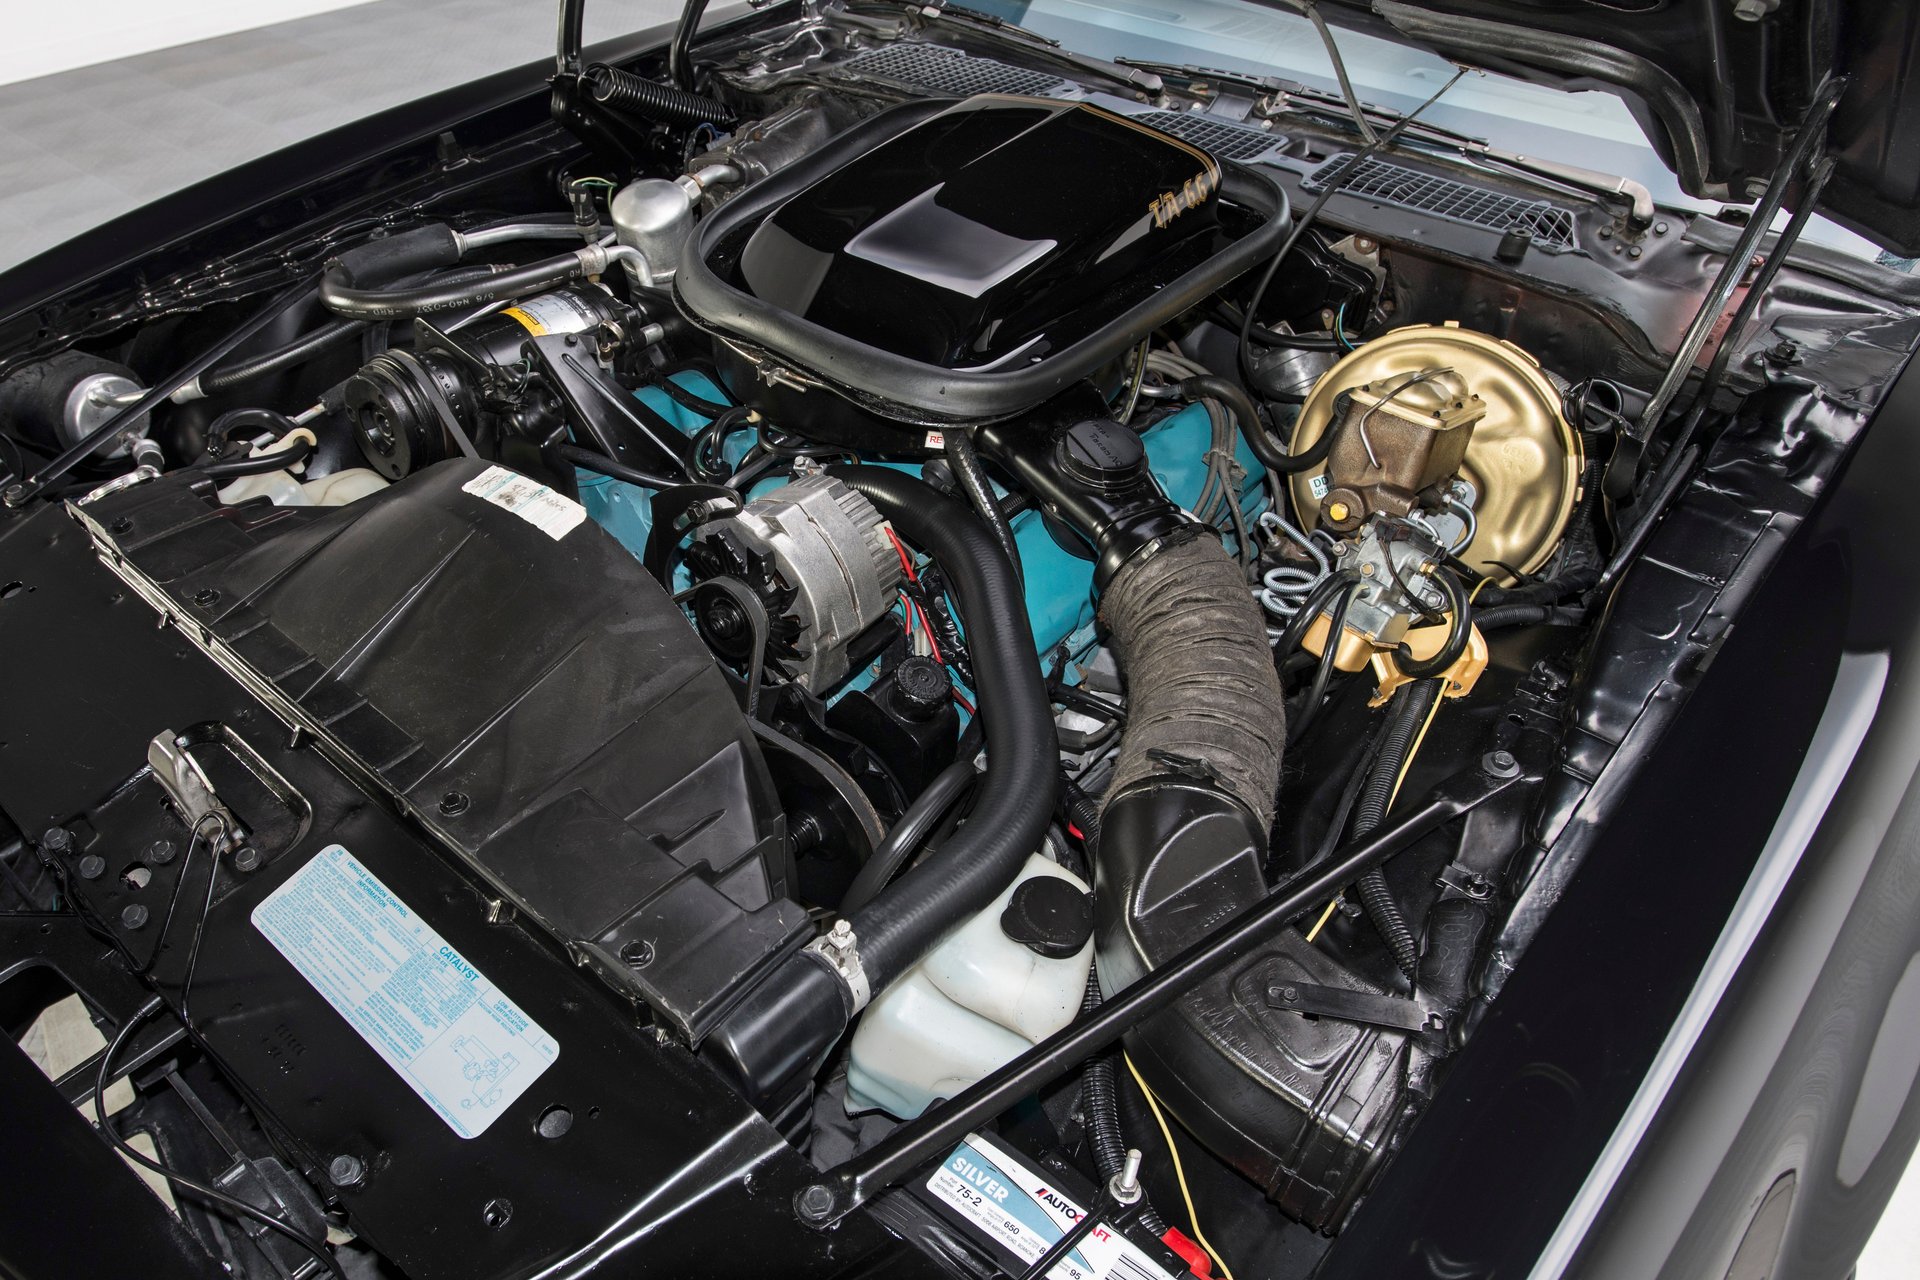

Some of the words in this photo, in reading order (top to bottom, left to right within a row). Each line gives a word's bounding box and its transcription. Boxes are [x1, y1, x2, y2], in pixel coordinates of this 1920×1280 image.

[347, 860, 367, 878] VEHICLE
[365, 877, 388, 898] EMISSION
[386, 897, 408, 918] CONTROL
[357, 880, 387, 908] INFORMATION
[440, 946, 479, 982] CATALYST
[493, 1004, 525, 1032] CERTIFICATION
[498, 1000, 509, 1010] LOW
[507, 1008, 529, 1028] ALTITUDE
[952, 1157, 1008, 1203] SILVER
[956, 1184, 982, 1207] 75-2
[1003, 1220, 1020, 1234] 650
[1043, 1193, 1111, 1242] AUTOCAFT
[1069, 1268, 1081, 1280] 95
